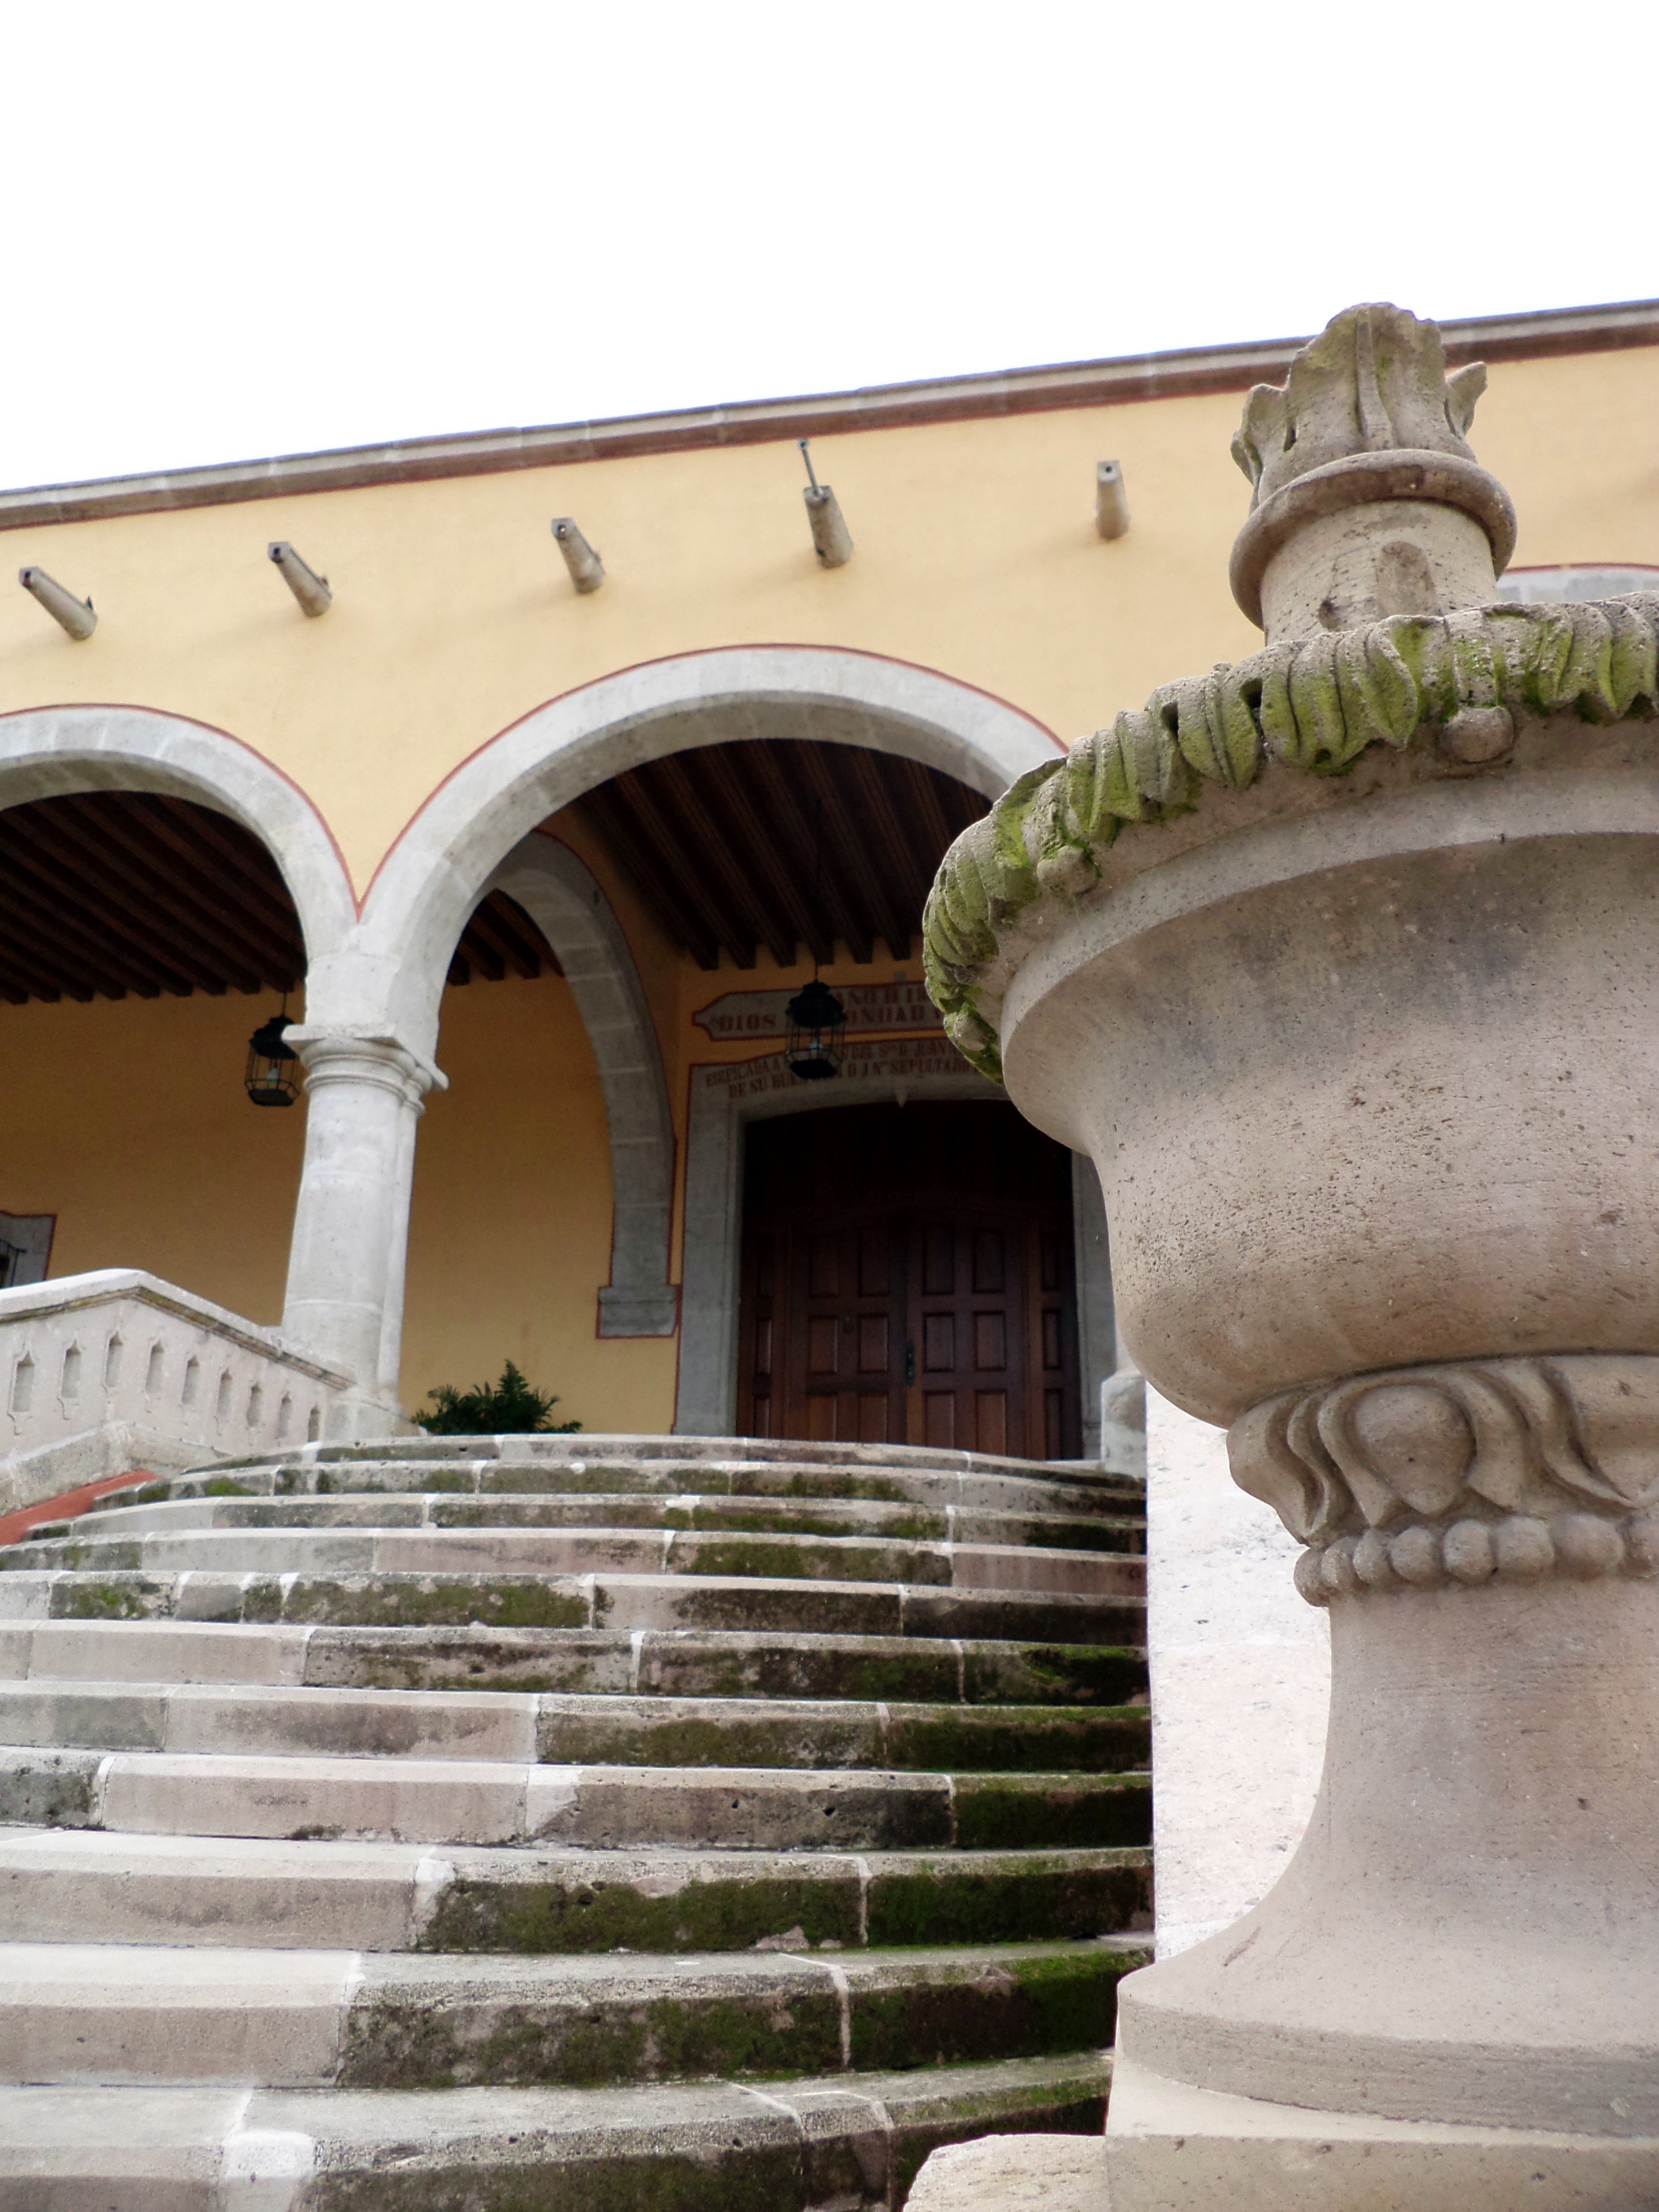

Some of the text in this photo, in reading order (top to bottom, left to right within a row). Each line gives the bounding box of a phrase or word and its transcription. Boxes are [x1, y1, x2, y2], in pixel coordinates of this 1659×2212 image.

[719, 1014, 777, 1032] DIOS
[844, 1004, 925, 1025] ONDAD
[706, 1058, 770, 1088] EDIFICADA
[729, 1081, 748, 1099] DE
